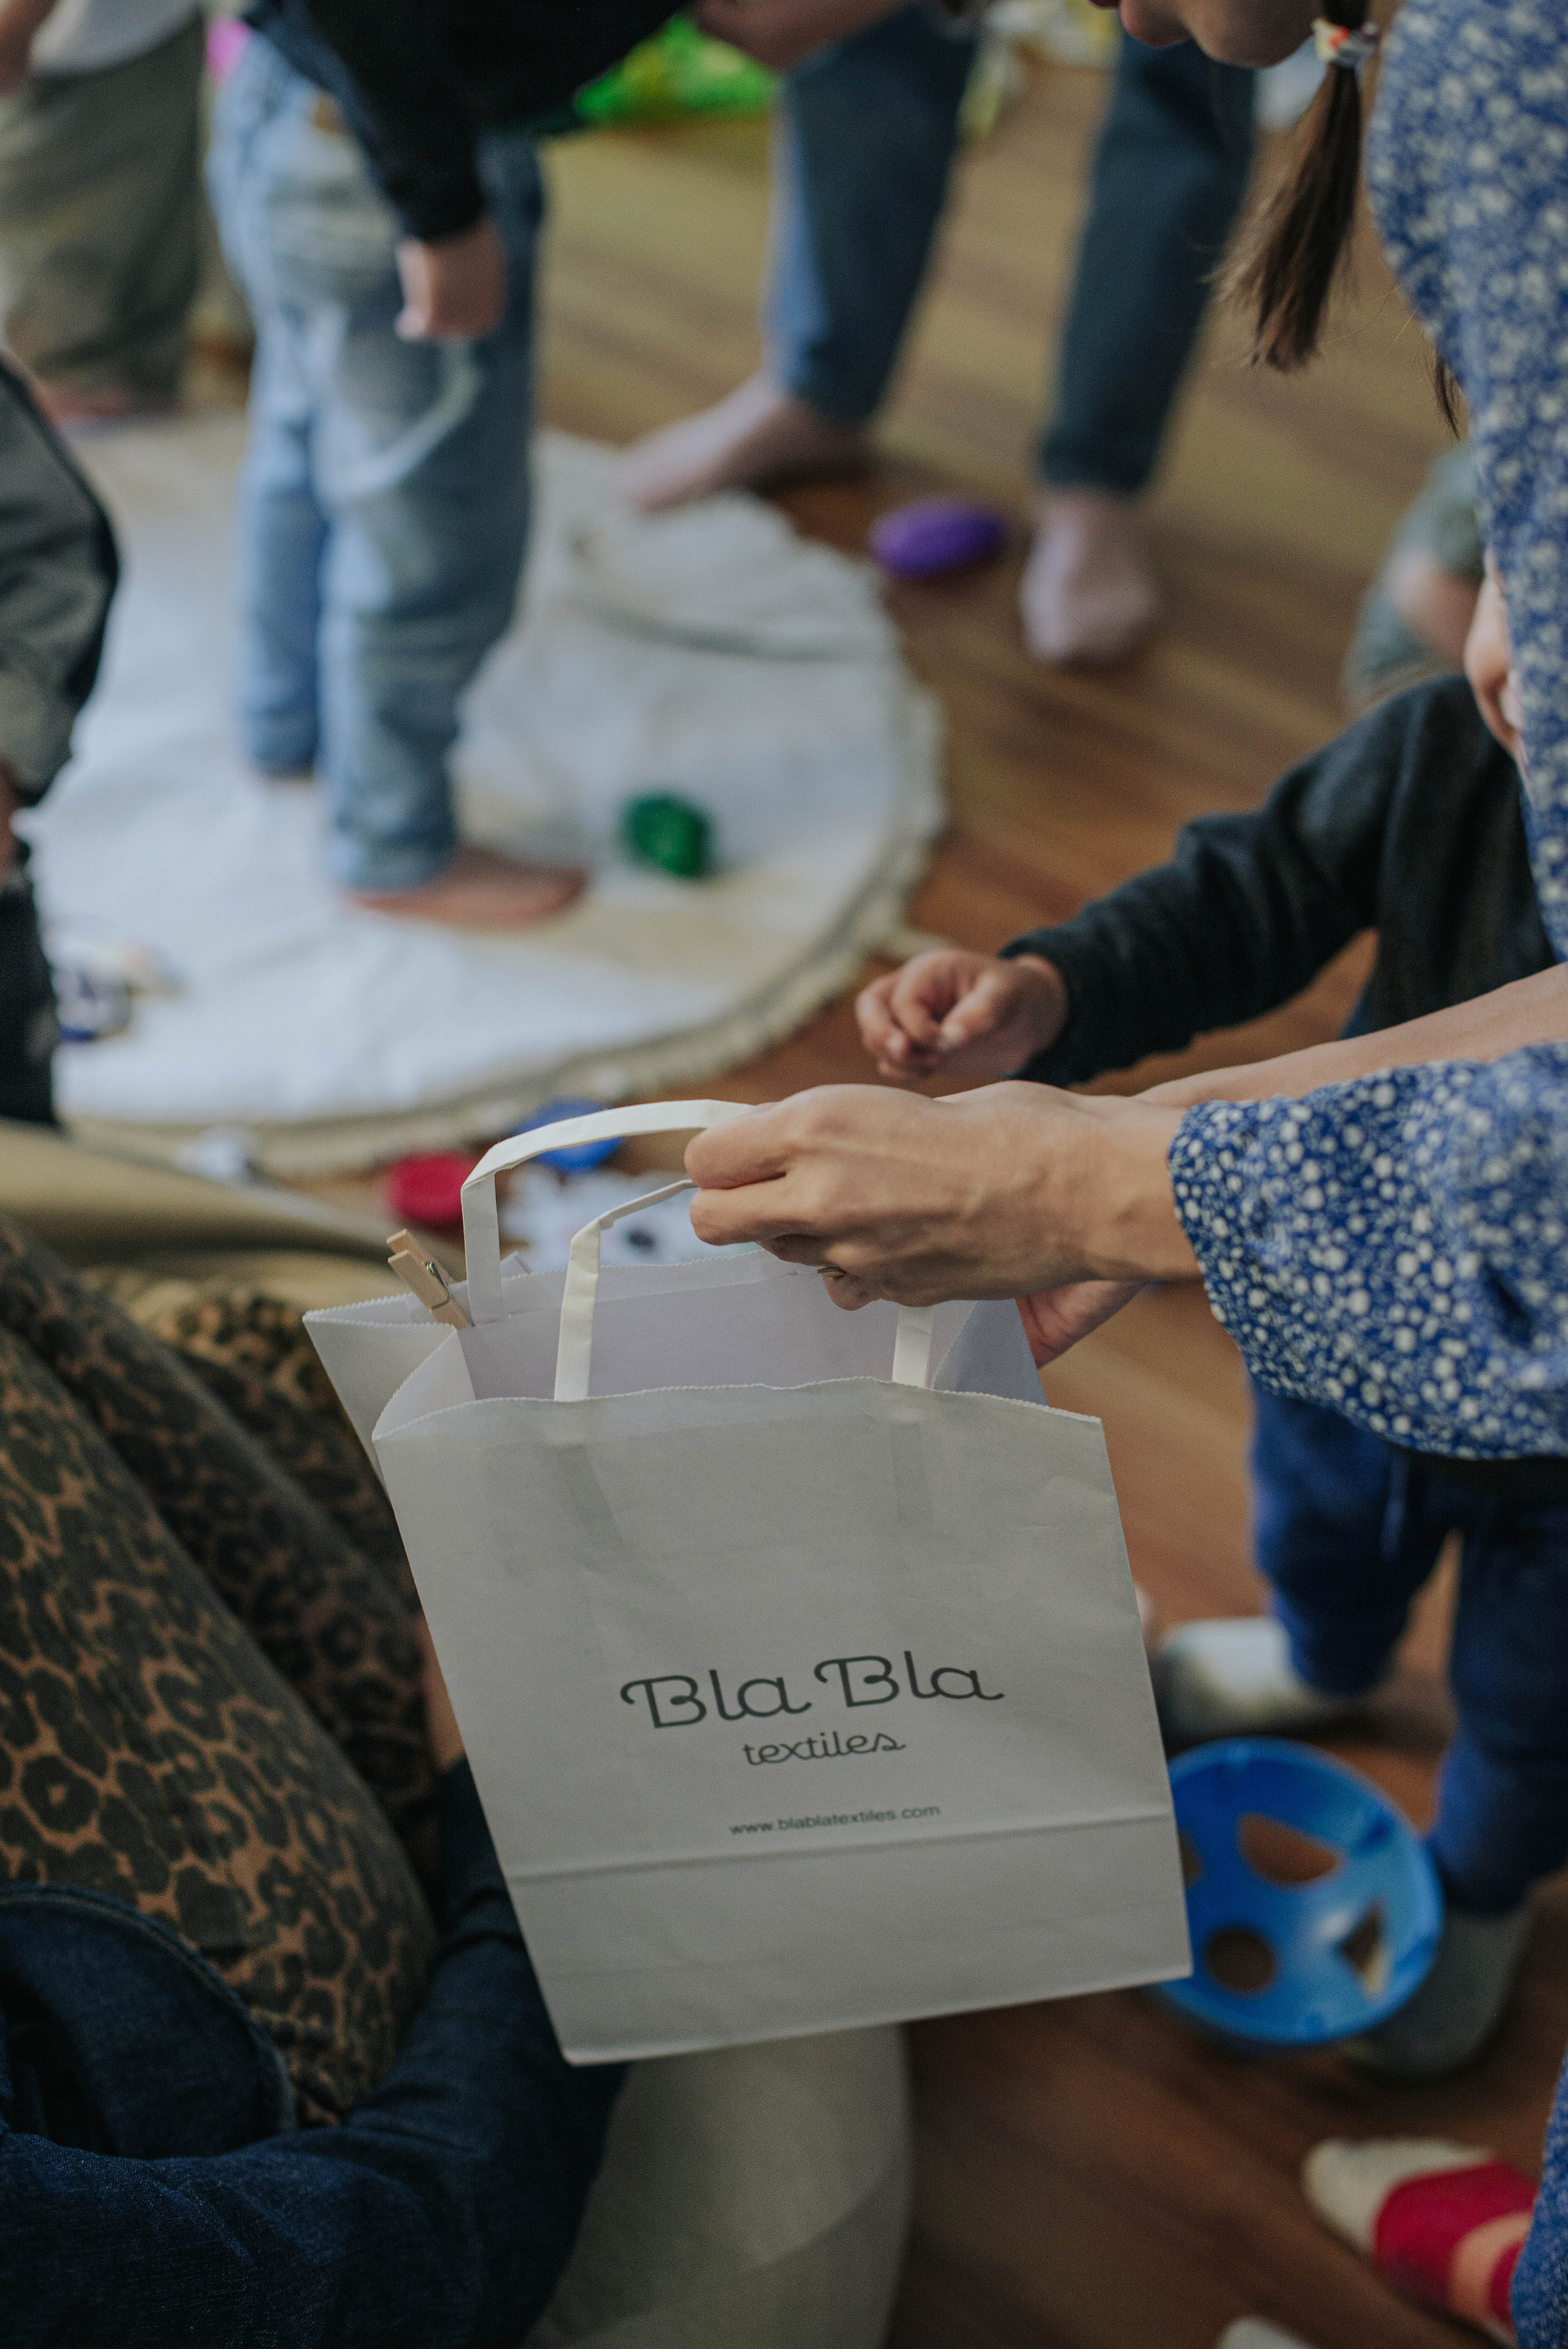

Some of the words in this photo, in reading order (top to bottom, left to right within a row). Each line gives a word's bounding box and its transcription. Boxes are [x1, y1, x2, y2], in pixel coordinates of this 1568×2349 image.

[620, 1669, 812, 1729] Bla
[813, 1651, 1005, 1708] Bla
[742, 1730, 907, 1765] textiles
[729, 1805, 941, 1834] www.blablatextiles.com
